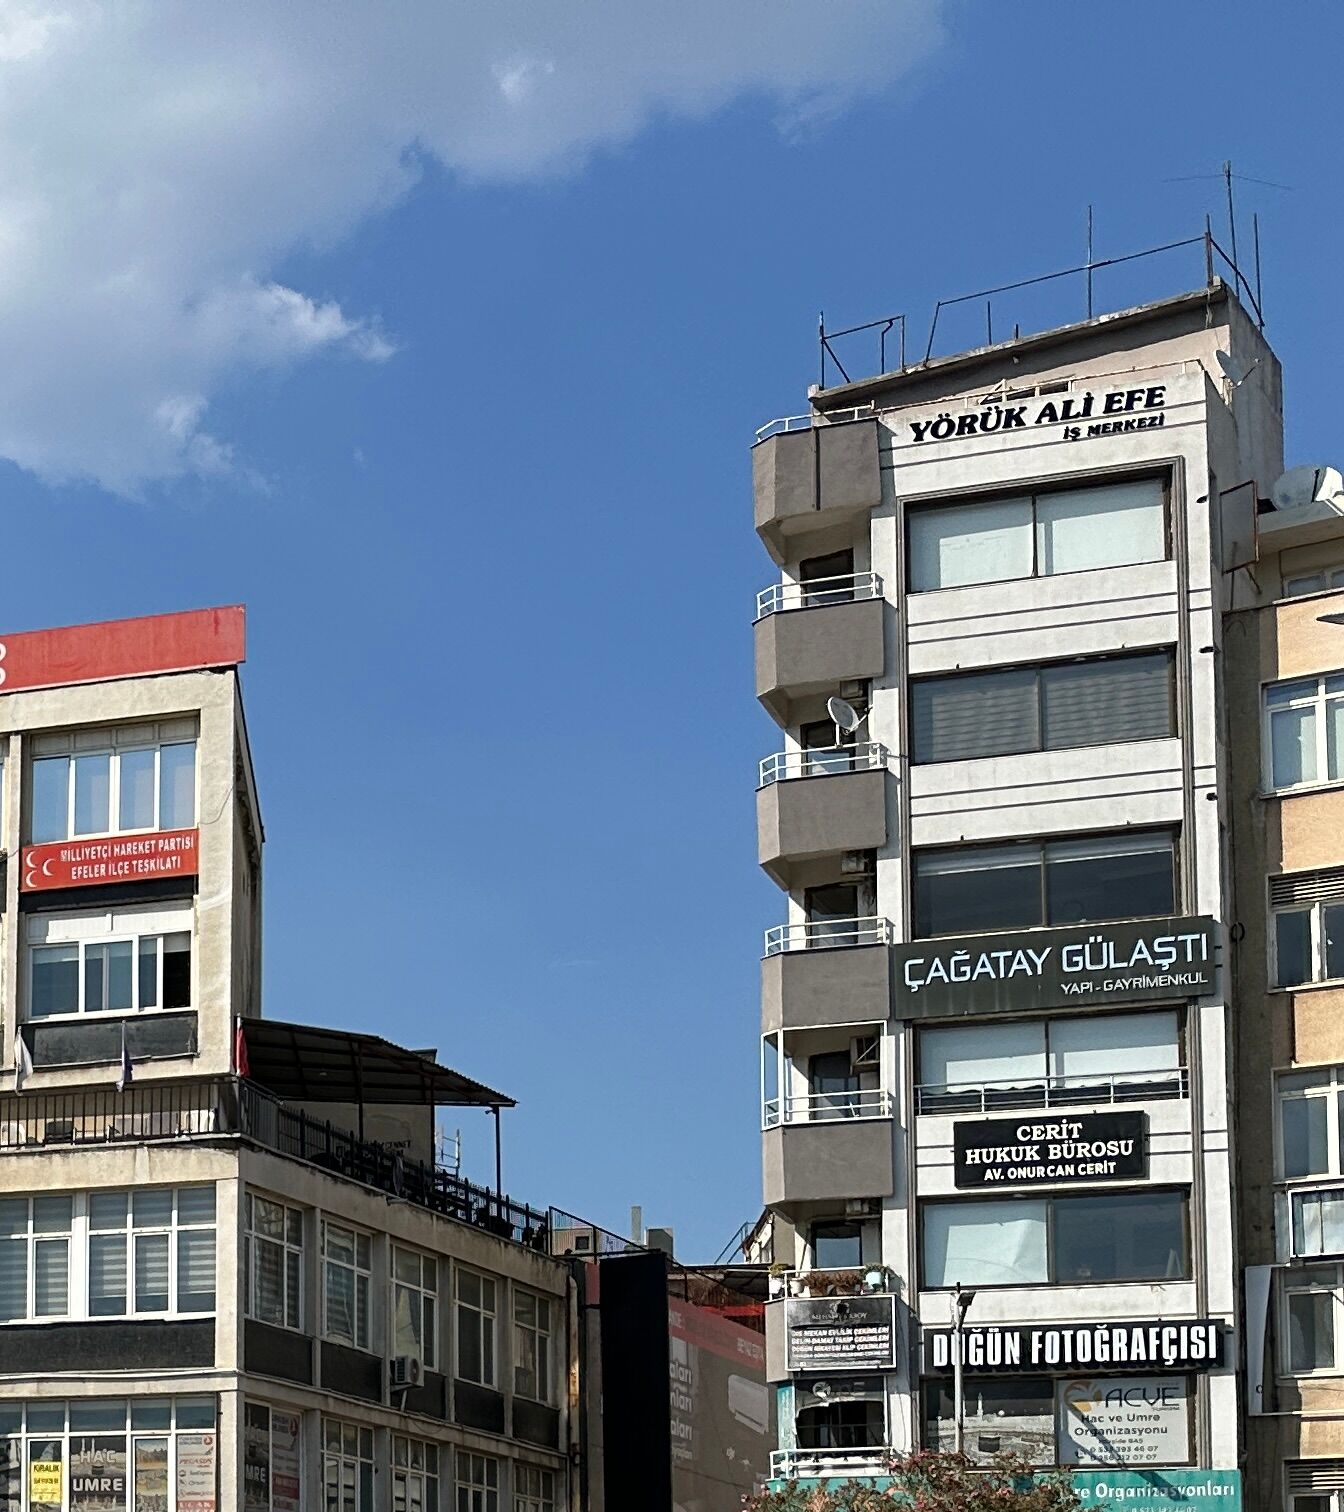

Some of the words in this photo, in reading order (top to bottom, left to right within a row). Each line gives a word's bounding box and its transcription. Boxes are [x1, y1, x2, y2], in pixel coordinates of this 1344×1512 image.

[910, 405, 1028, 442] YÖRÜK
[1035, 392, 1094, 424] ALİ
[1103, 386, 1166, 414] EFE
[1063, 426, 1081, 441] İŞ
[1087, 412, 1164, 438] MERKEZİ
[61, 845, 112, 862] MİLLİYETÇİ
[114, 839, 156, 857] HAREKET
[158, 833, 194, 851] PARTİSİ
[71, 863, 106, 880] EFELER
[108, 860, 129, 878] İLÇE
[132, 857, 181, 875] TEŞKİLATI
[904, 947, 1052, 992] ÇAĞATAY
[1062, 933, 1208, 972] GÜLAŞTI
[1061, 981, 1093, 995] YAPI
[1103, 971, 1208, 992] GAYRİMENKUL
[1017, 1118, 1083, 1141] CERİT
[965, 1145, 1041, 1165] HUKUK
[1048, 1140, 1134, 1160] BÜROSU
[984, 1168, 1004, 1181] AV.
[1078, 1160, 1116, 1176] CERİT
[1031, 1324, 1217, 1365] FOTOĞRAFÇISI
[1105, 1387, 1180, 1408] ACVE
[1081, 1414, 1104, 1423] Hac
[1108, 1415, 1122, 1423] ve
[1127, 1413, 1161, 1422] Umre
[1074, 1426, 1168, 1436] Organizasyonu
[73, 1478, 123, 1492] UMRE
[245, 1464, 266, 1483] MRE
[1074, 1485, 1089, 1498] re
[1096, 1480, 1235, 1502] Organizasyonları
